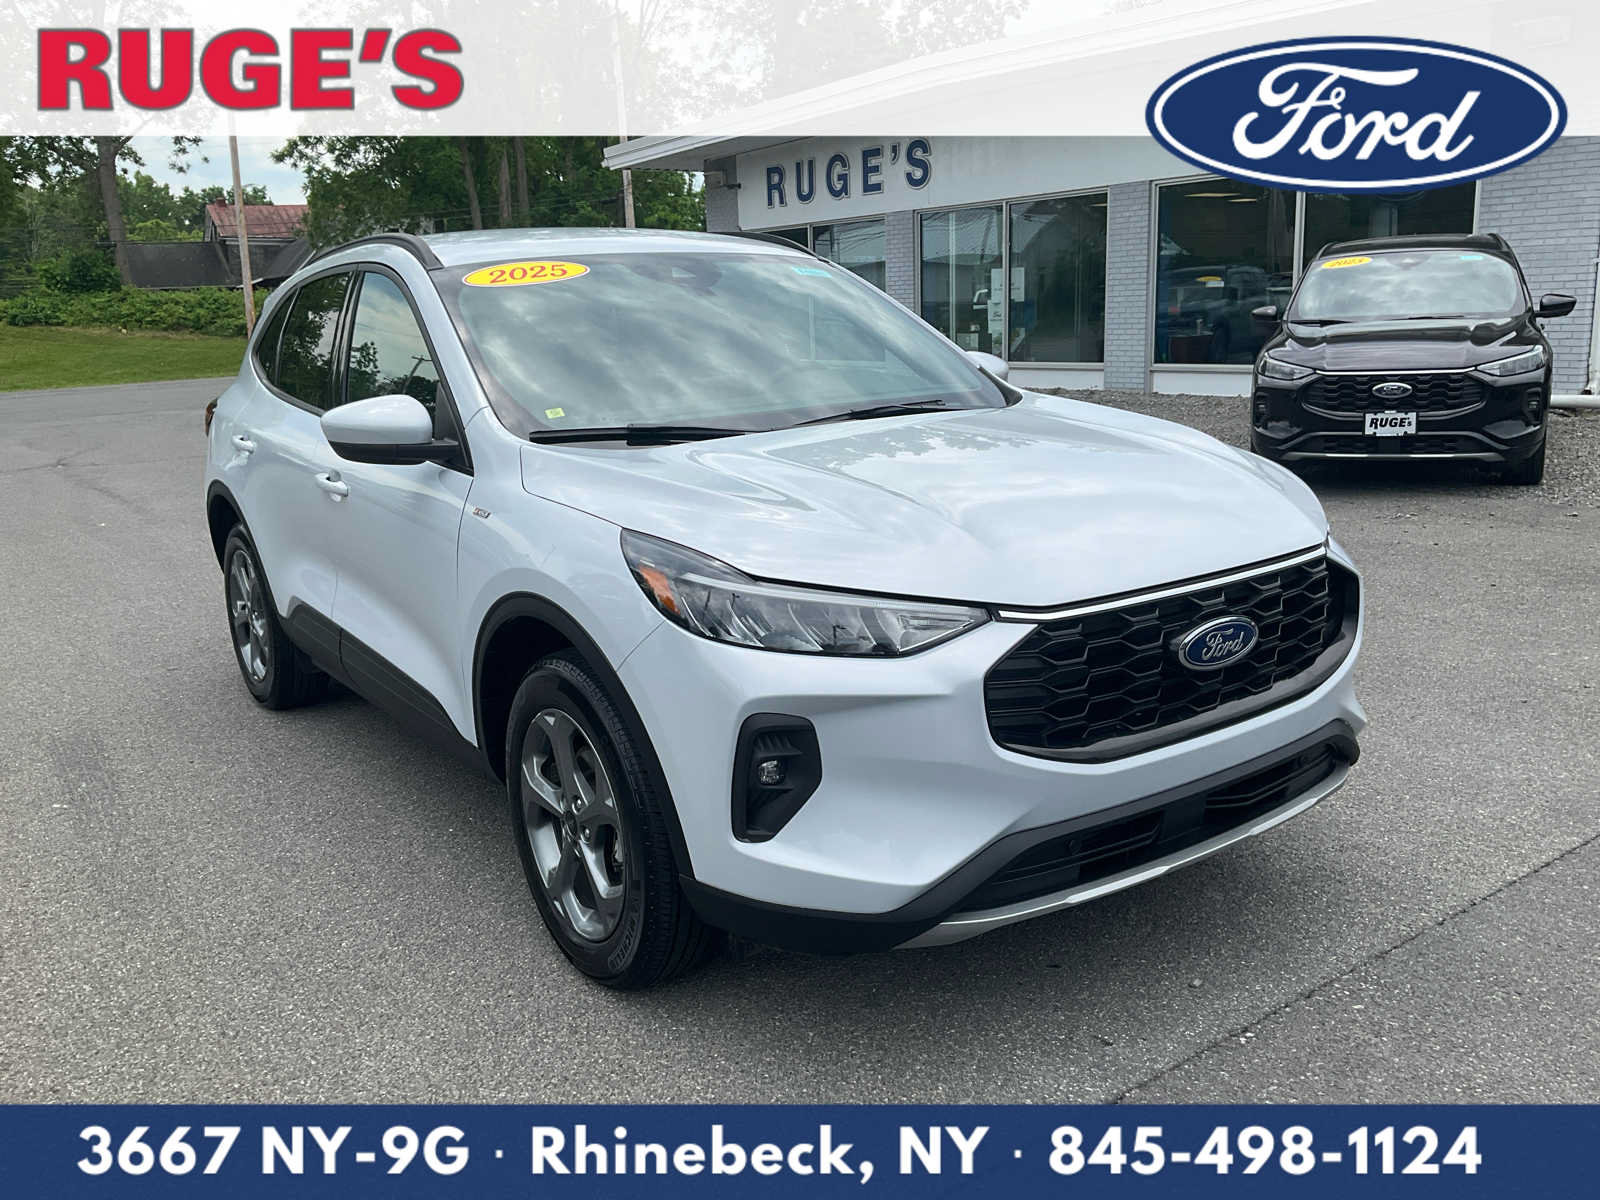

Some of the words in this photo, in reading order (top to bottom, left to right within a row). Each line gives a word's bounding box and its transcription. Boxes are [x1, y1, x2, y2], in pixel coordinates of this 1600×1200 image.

[766, 138, 931, 208] RUGE'S
[489, 264, 568, 284] 2025
[1202, 627, 1244, 661] Ford
